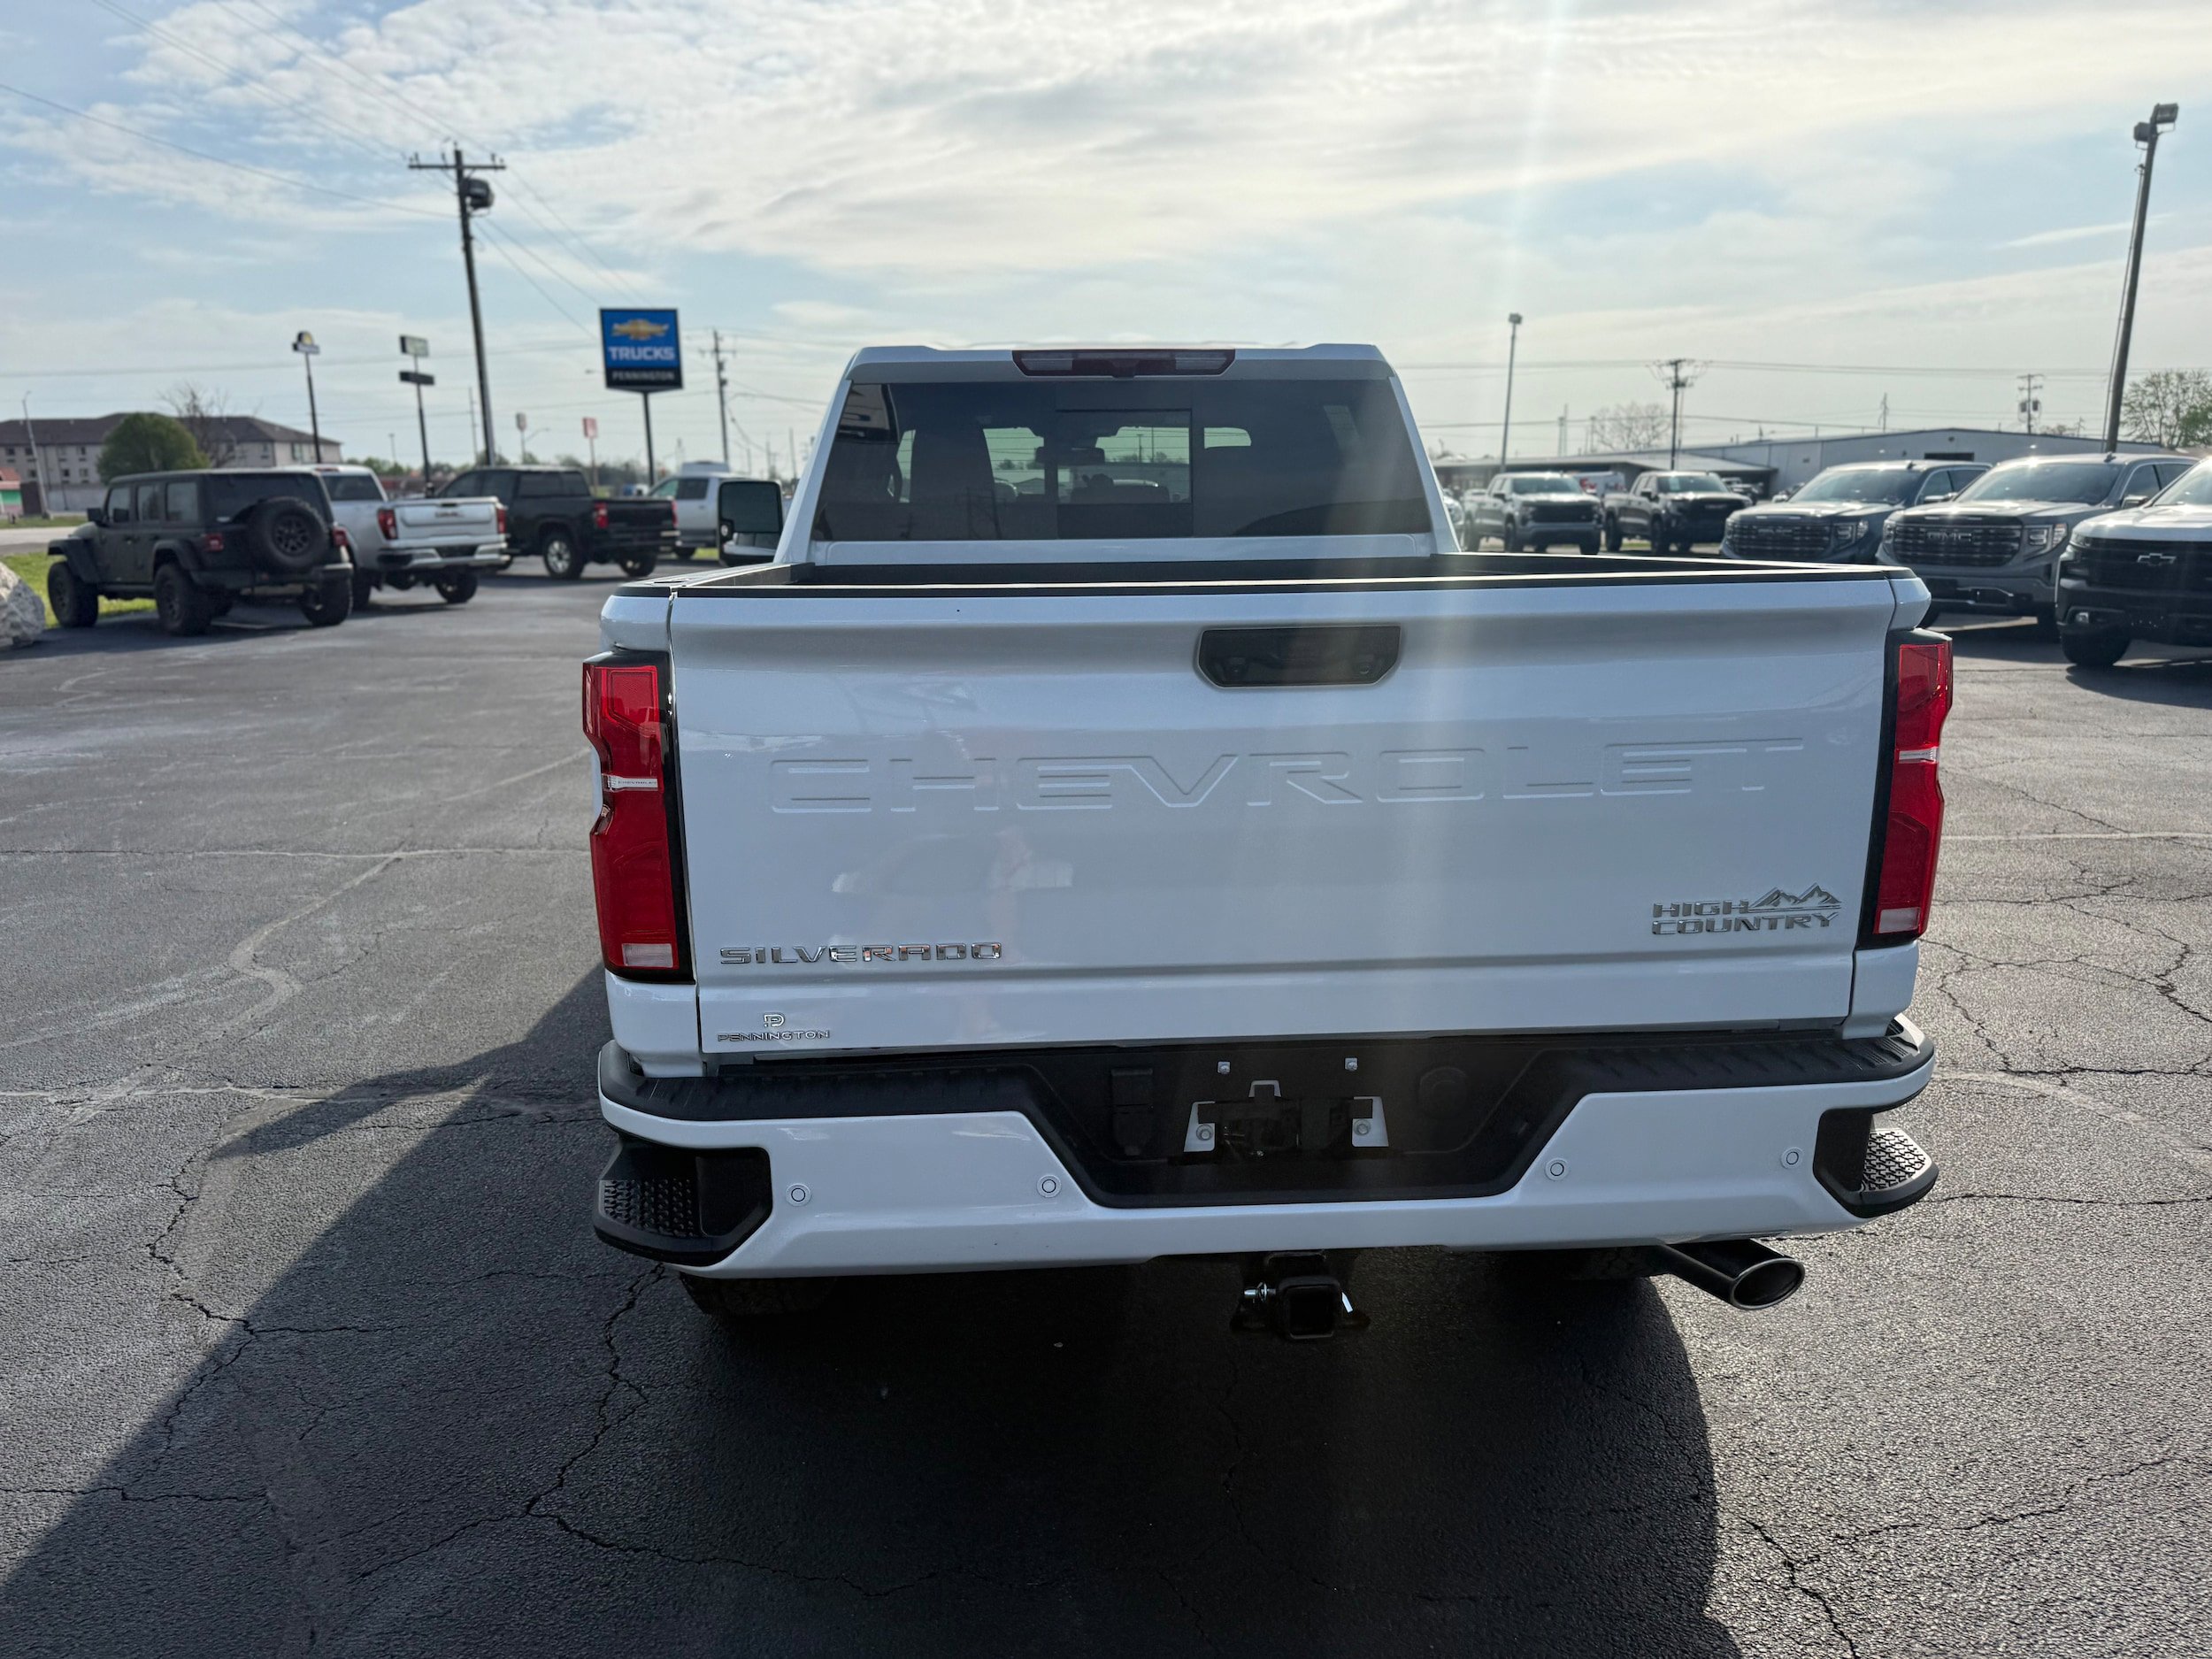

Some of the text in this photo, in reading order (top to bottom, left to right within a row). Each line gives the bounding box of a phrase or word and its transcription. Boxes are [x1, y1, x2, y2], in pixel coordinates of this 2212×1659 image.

[609, 346, 675, 360] TRUCKS
[612, 371, 675, 380] PENNINGTON
[771, 738, 1804, 814] CHEVROLET
[1653, 899, 1749, 918] HIGH
[1652, 912, 1839, 934] COUNTRY
[719, 942, 1002, 964] SILVERADO
[718, 1030, 830, 1042] PENNINGTON
